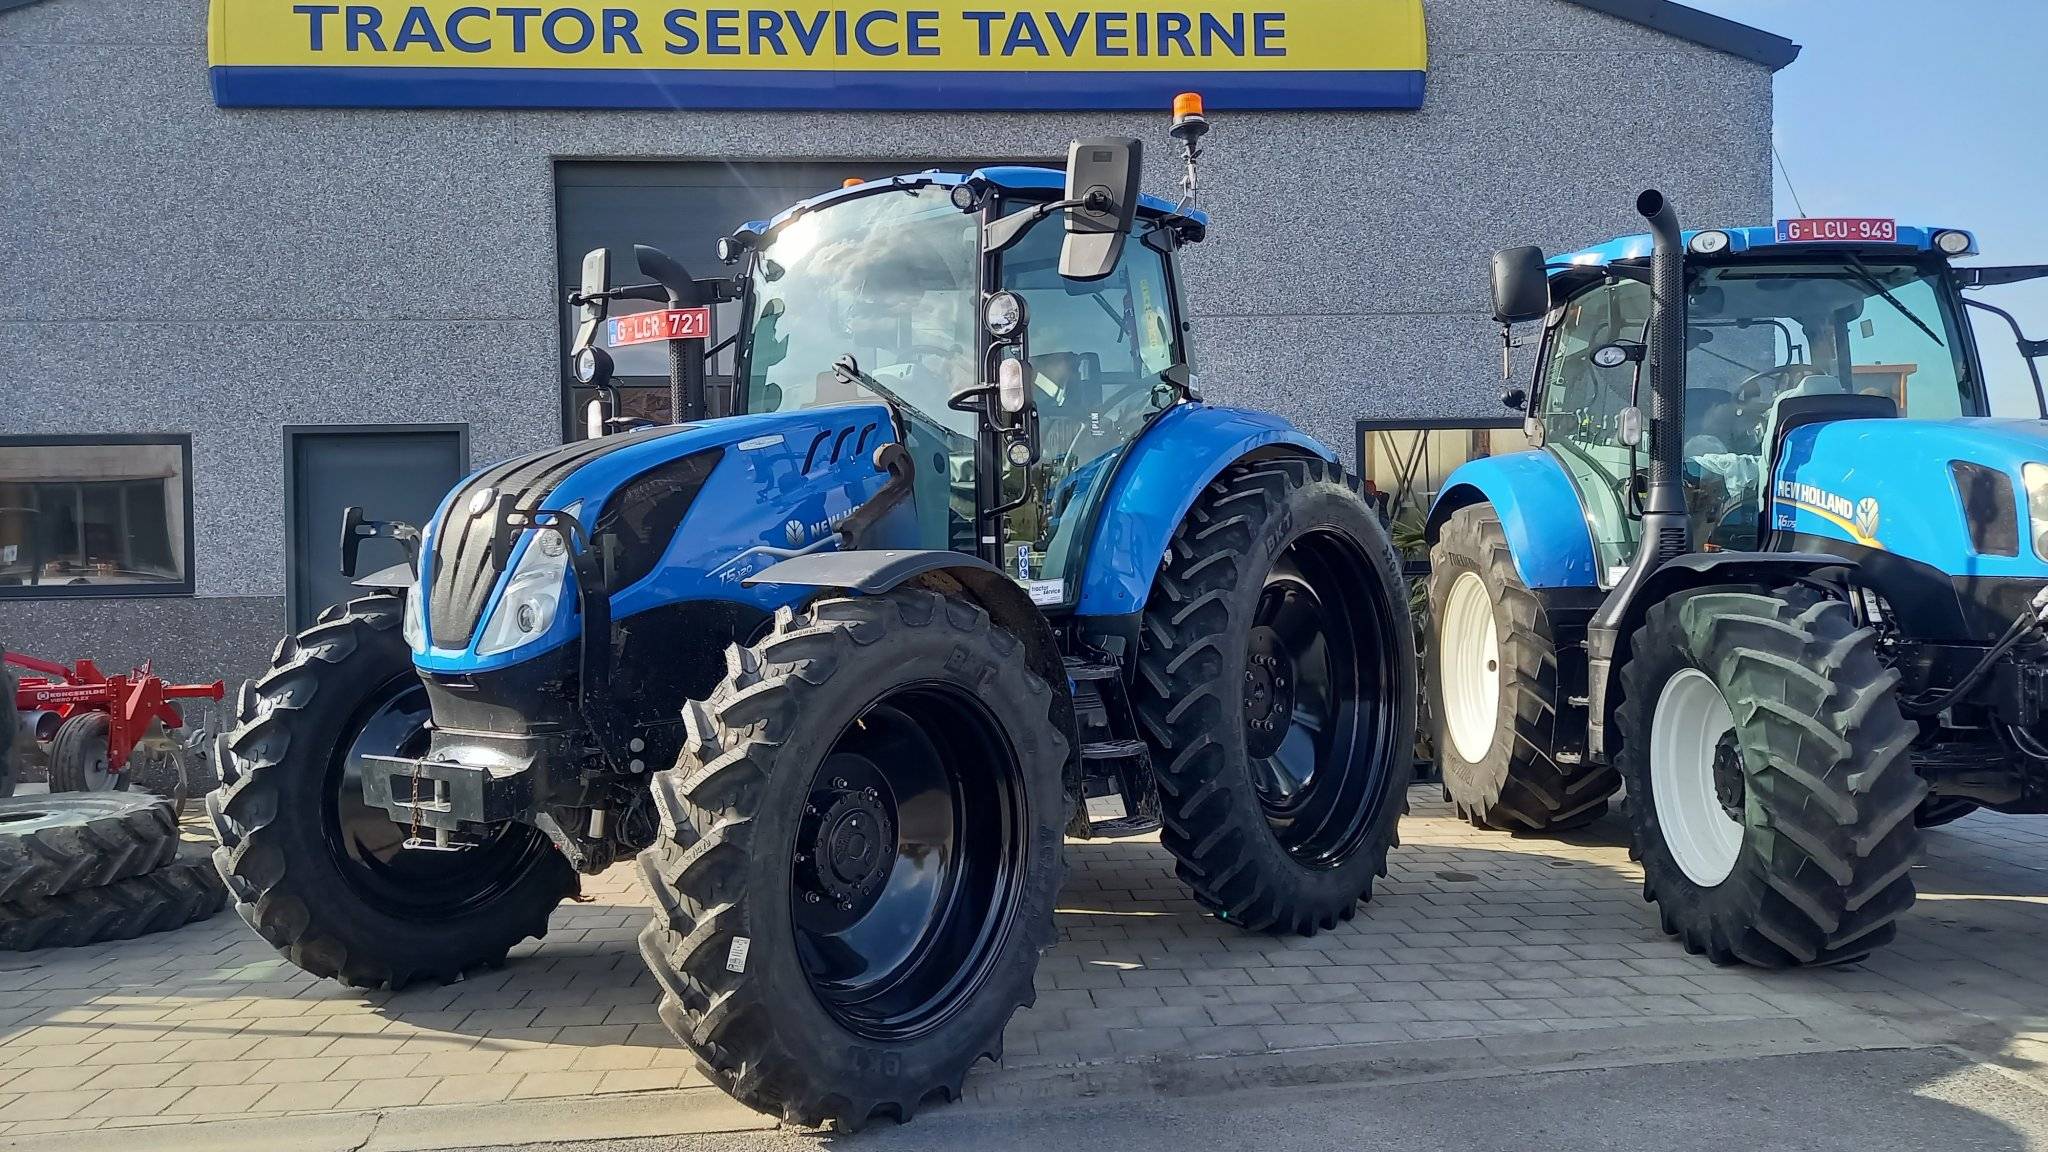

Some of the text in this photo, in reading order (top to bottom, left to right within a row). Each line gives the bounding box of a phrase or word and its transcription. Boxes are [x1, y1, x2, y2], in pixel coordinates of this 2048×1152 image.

[293, 5, 1287, 57] TRACTOR SERVICE TAVEIRNE
[1788, 221, 1893, 239] G-LCU-949
[617, 313, 704, 340] G-LCR-721
[1778, 480, 1853, 520] NEW HOLLAND
[50, 689, 105, 697] KONGSKILDE
